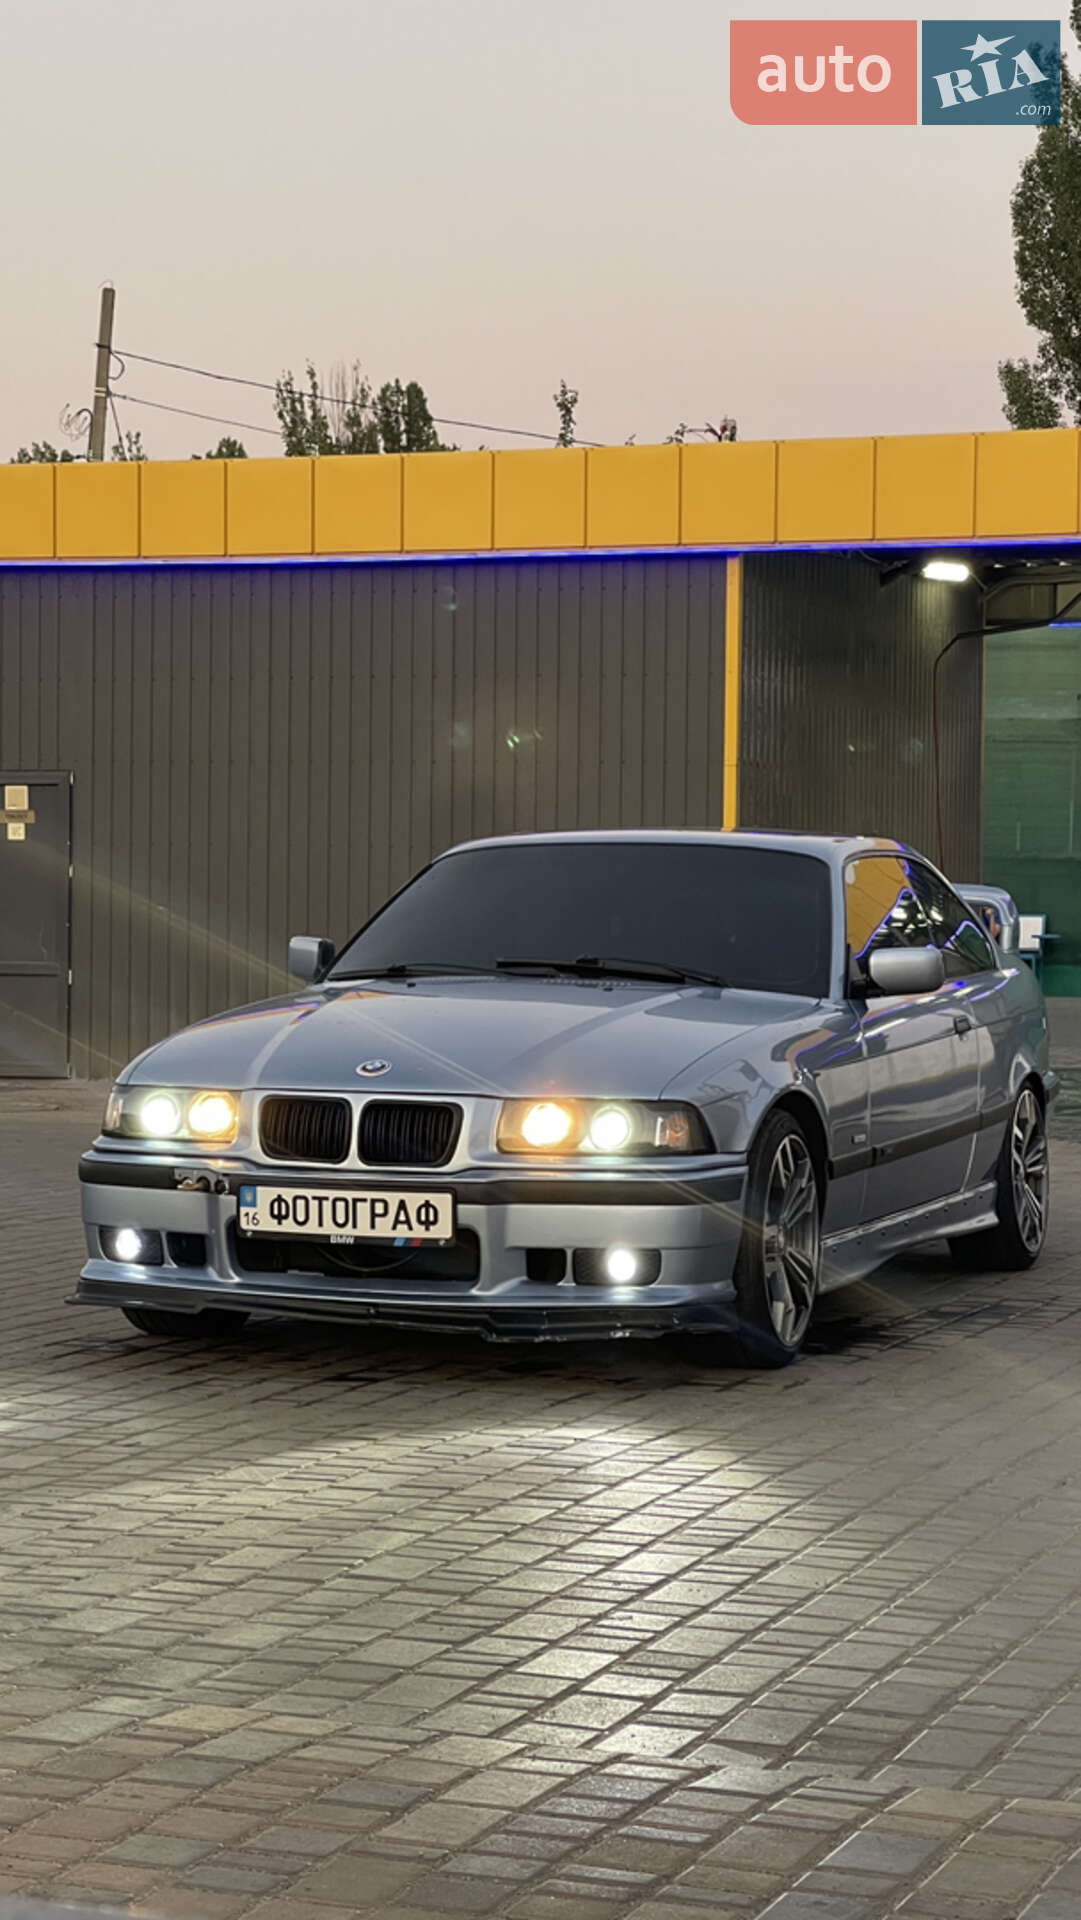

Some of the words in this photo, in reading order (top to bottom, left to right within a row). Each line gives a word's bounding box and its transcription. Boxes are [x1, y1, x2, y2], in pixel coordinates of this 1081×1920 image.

[243, 1212, 260, 1227] 16
[269, 1194, 438, 1231] ФОТОГРАФ
[330, 1235, 355, 1244] BMW
